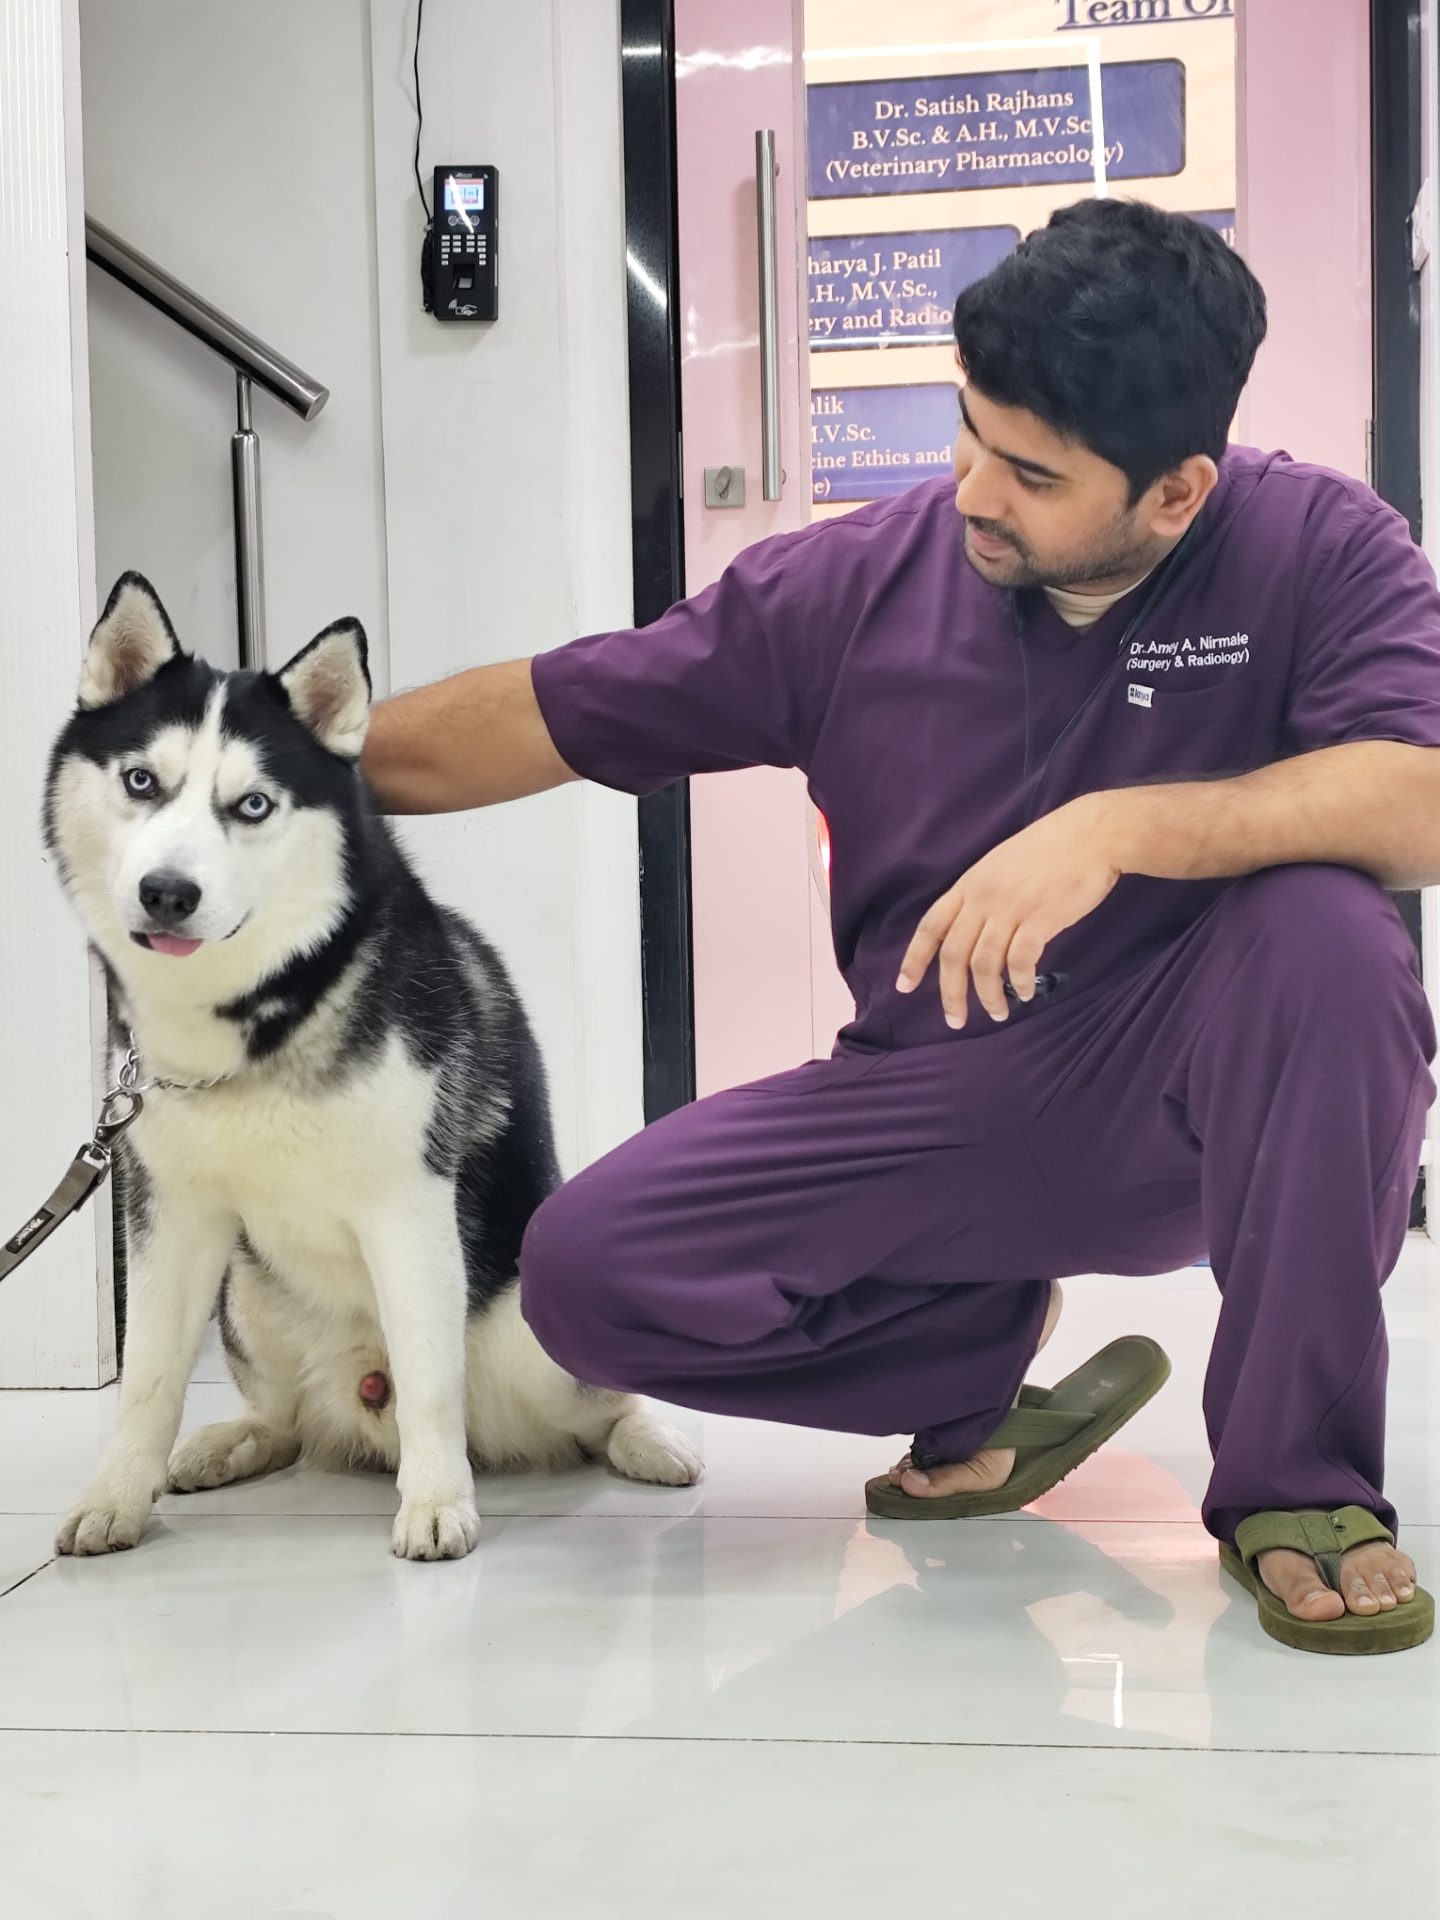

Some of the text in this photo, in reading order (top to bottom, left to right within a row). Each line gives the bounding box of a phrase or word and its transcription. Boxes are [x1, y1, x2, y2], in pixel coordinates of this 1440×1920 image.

[1055, 0, 1172, 26] Team
[874, 89, 1074, 120] Dr. Satish Rajhans
[852, 127, 926, 149] B.V.Sc.
[931, 125, 950, 144] &
[955, 121, 1009, 142] A.H.,
[825, 154, 951, 183] (Veterinary
[869, 252, 887, 276] J.
[893, 248, 942, 271] Patil
[851, 279, 938, 301] M.V.Sc.,
[842, 308, 883, 330] and
[851, 449, 910, 467] Ethics
[915, 445, 952, 463] and
[1181, 638, 1197, 652] A.
[1200, 631, 1249, 651] Nirmale
[1126, 647, 1250, 672] (Surgery & Radiology)
